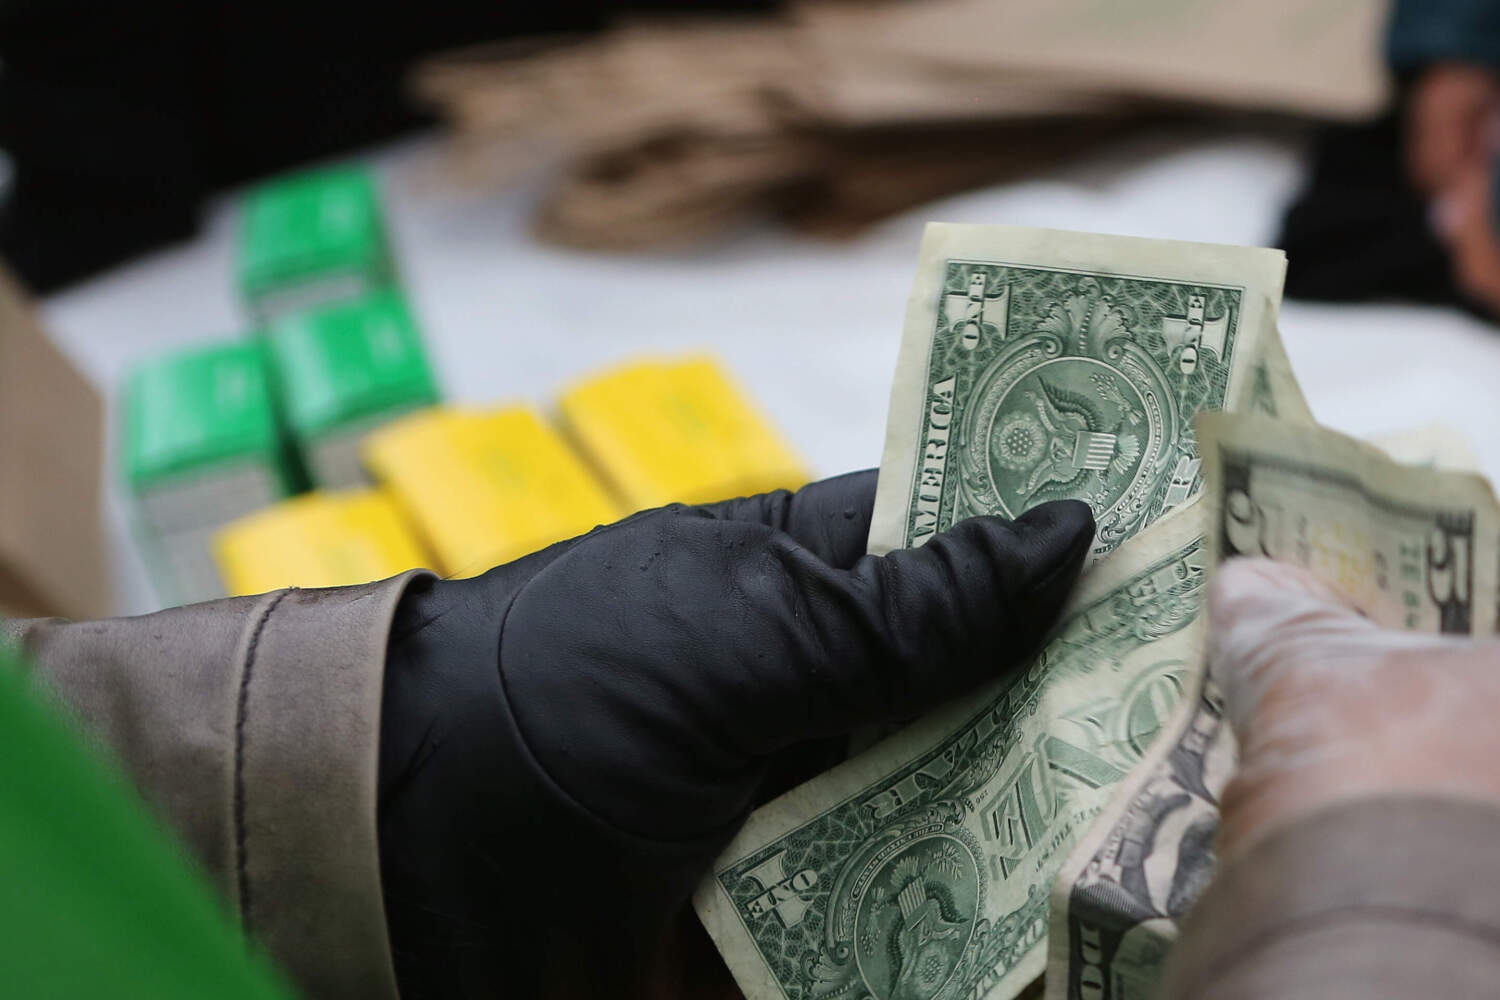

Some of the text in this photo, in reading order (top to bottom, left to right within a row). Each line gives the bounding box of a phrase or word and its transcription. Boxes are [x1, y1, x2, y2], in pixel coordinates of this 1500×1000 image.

[962, 272, 986, 350] ONE
[1180, 293, 1205, 375] ONE
[746, 868, 818, 917] ONE
